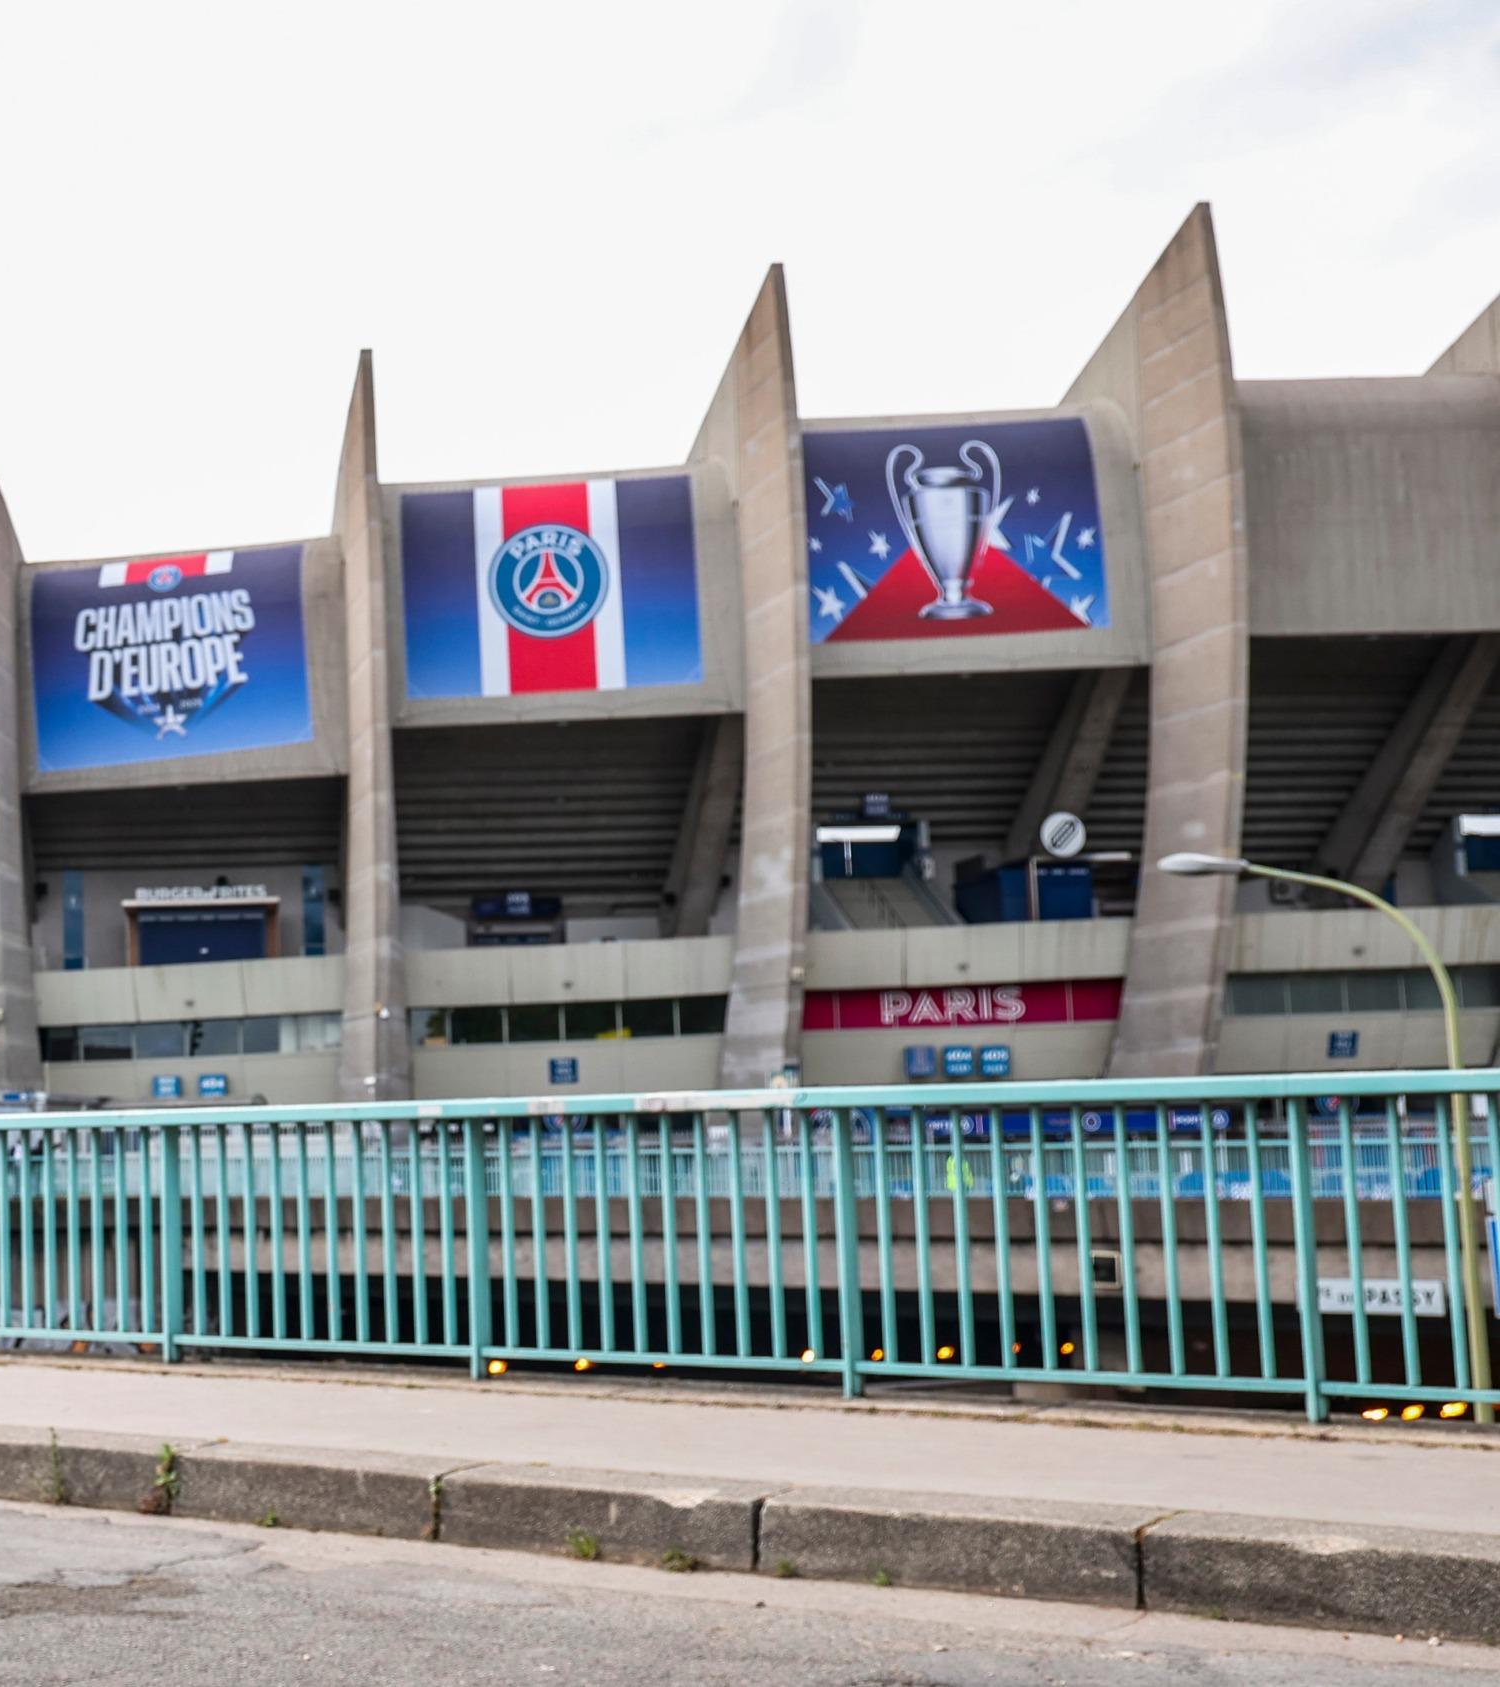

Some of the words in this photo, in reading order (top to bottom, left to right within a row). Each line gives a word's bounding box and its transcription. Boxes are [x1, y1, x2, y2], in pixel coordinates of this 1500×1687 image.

[508, 530, 584, 560] PARIS
[74, 588, 256, 652] CHAMPIONS
[88, 633, 249, 702] D'EUROPE
[880, 985, 1026, 1025] PARIS
